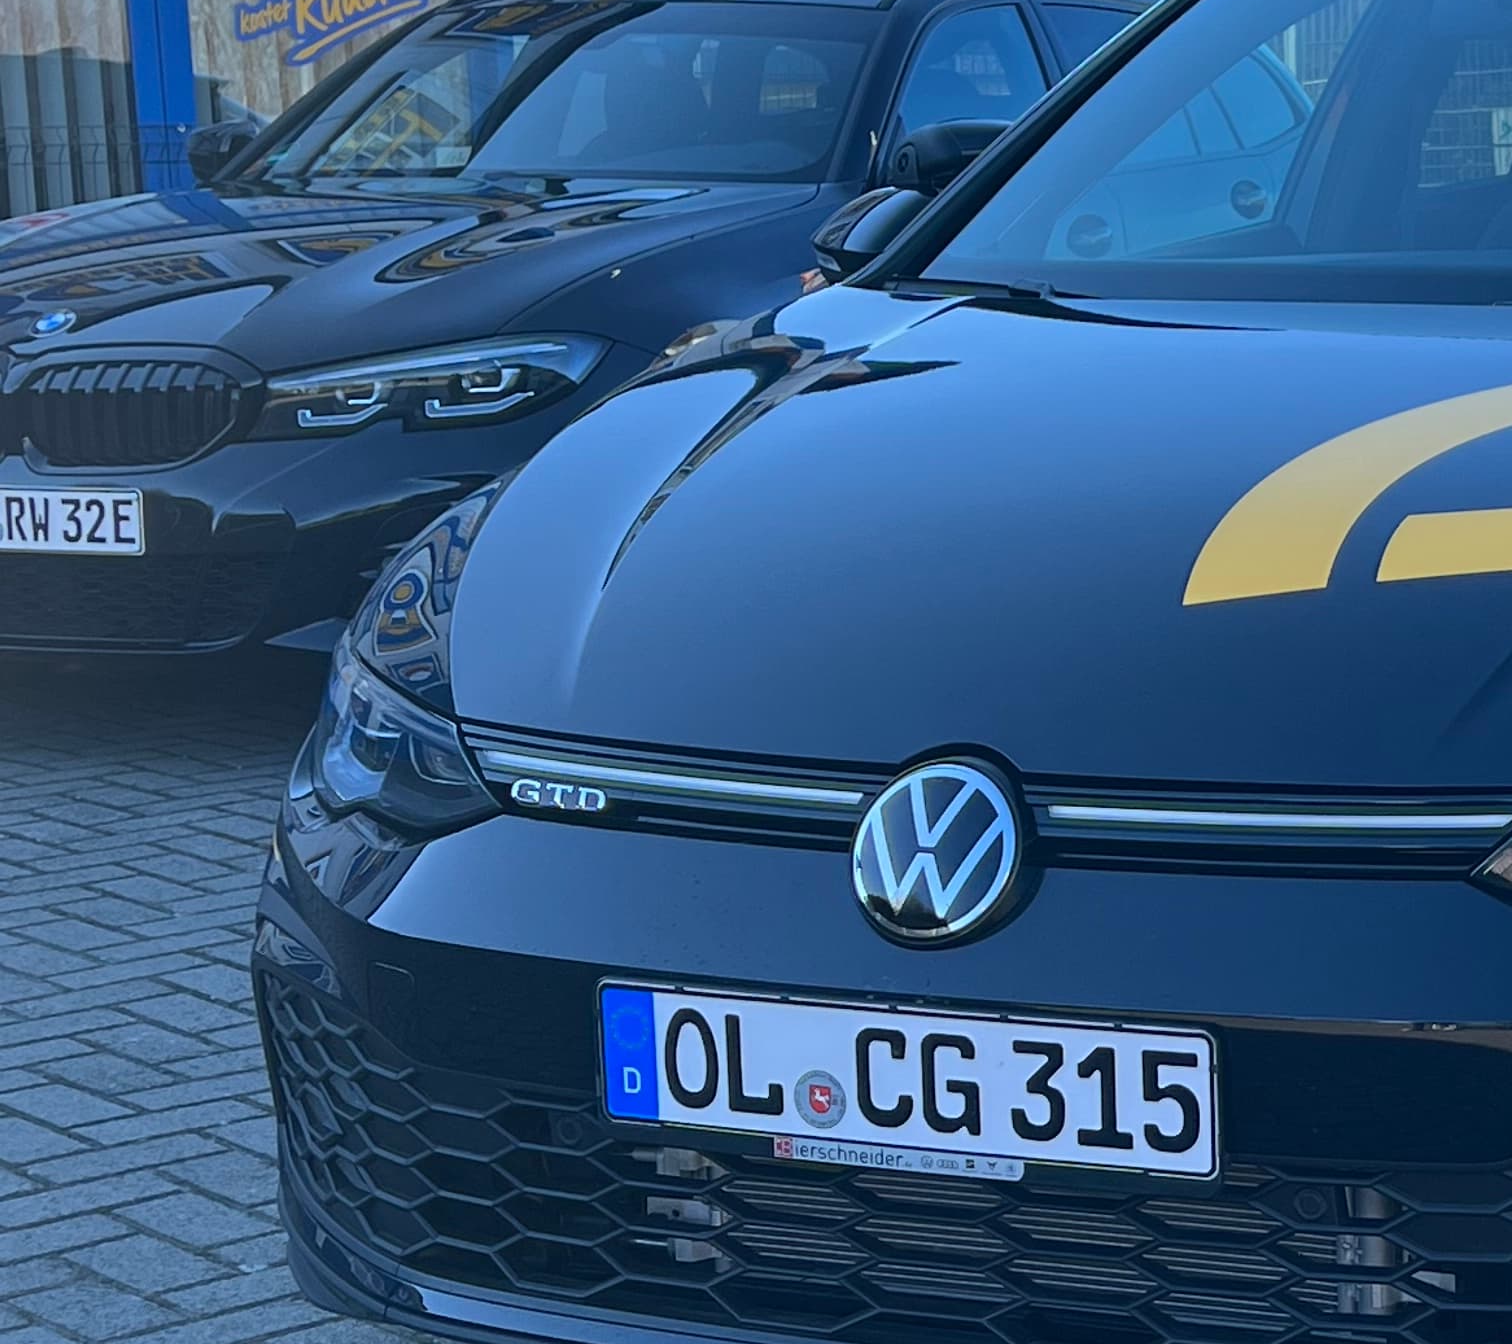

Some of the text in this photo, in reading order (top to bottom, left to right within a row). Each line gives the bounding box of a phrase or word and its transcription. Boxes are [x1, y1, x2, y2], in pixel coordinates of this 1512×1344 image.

[5, 496, 136, 545] RW 32E
[510, 777, 607, 813] GTD
[622, 1066, 642, 1094] D
[664, 1007, 785, 1117] OL
[855, 1027, 983, 1137] CG
[1010, 1039, 1200, 1154] 315
